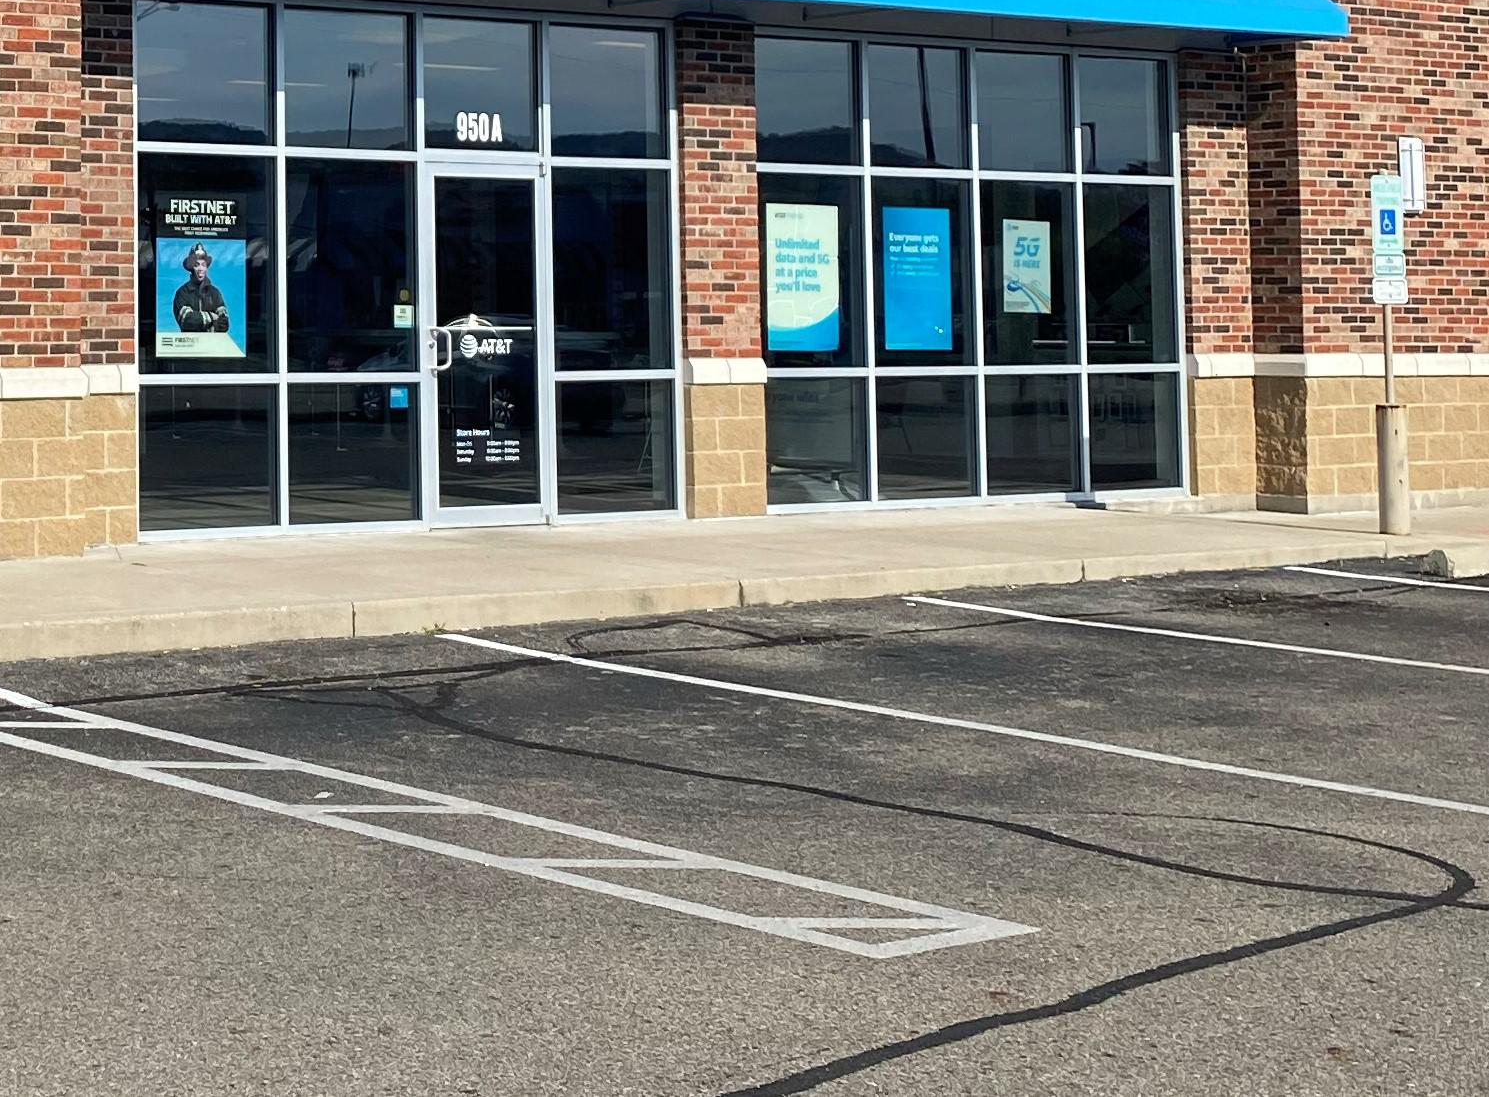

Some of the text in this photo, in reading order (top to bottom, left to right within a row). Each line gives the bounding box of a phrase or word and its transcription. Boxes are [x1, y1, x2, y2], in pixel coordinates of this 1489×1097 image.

[170, 199, 233, 214] FIRSTNET
[165, 214, 237, 225] BUILT WITH AT&T
[775, 238, 820, 250] Unlimited
[889, 232, 939, 244] Everyone gets
[889, 244, 939, 253] our best deals
[1013, 236, 1040, 257] 5G
[775, 252, 830, 264] data and 5G
[775, 267, 818, 281] at a price
[802, 282, 821, 293] love
[478, 338, 513, 354] AT&T
